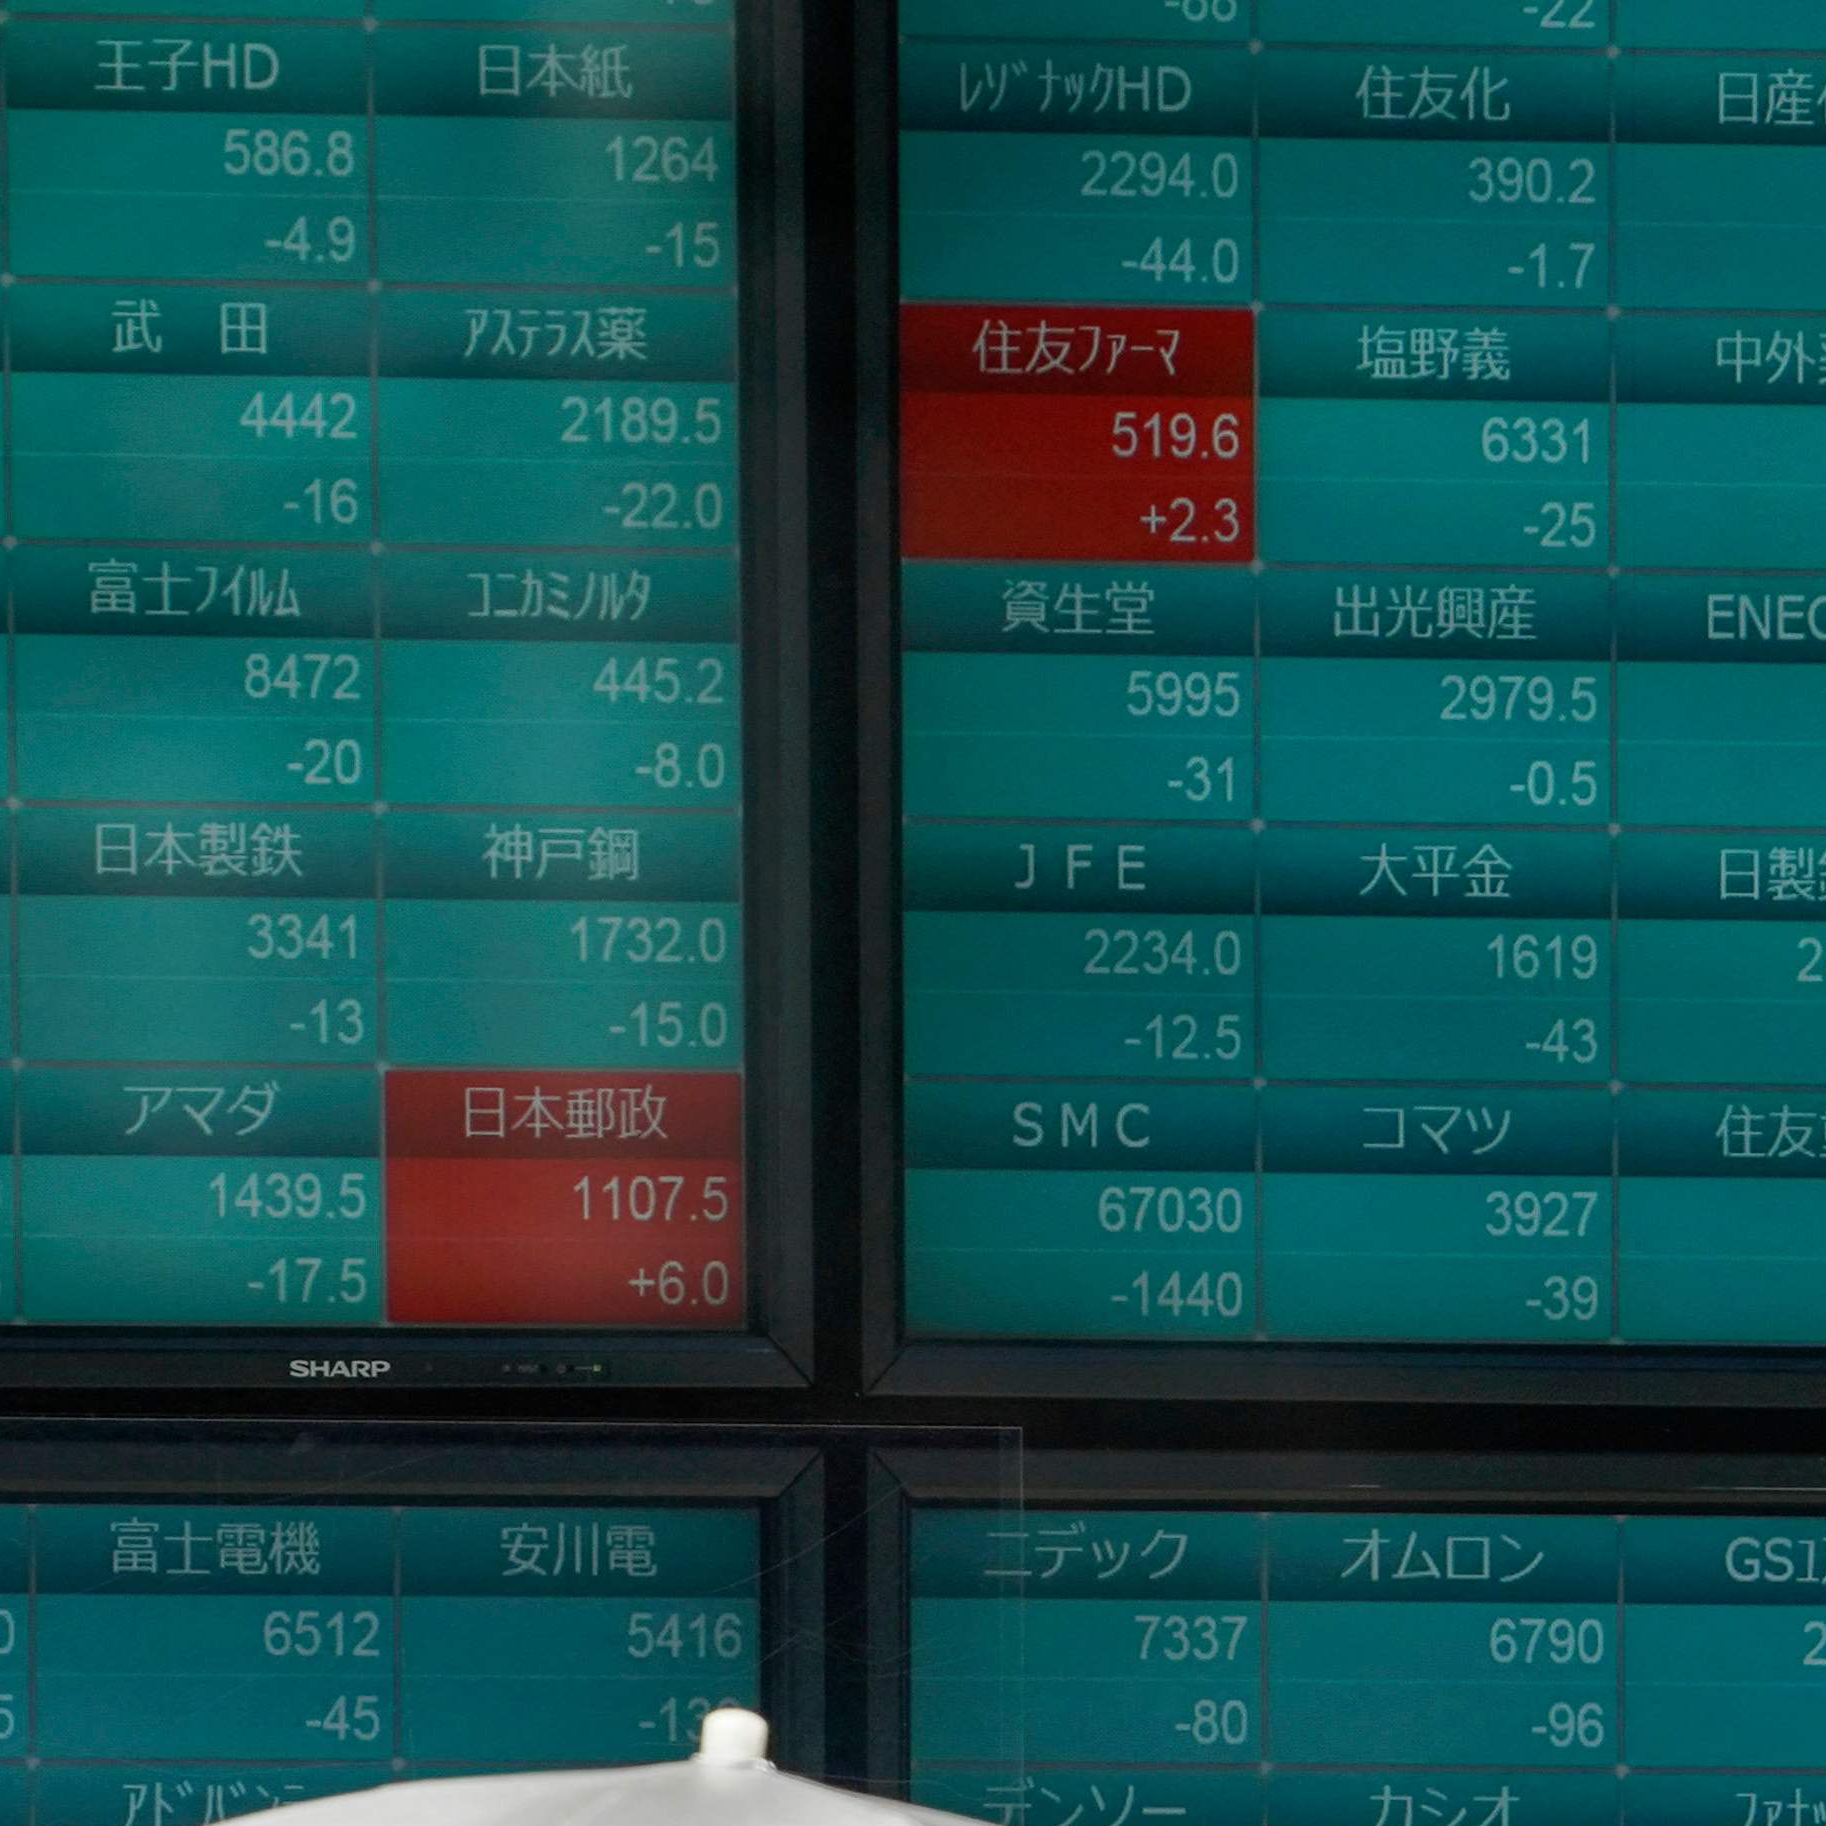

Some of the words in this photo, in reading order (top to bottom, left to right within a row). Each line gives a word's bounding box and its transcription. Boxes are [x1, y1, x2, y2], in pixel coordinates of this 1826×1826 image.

[95, 39, 280, 91] 王子HD
[478, 44, 632, 98] 日本紙
[1356, 65, 1510, 121] 住友化
[607, 135, 718, 182] 1264
[1470, 157, 1595, 204] 390.2
[1357, 325, 1510, 380] 塩野義
[241, 391, 357, 439] 4442
[560, 395, 722, 445] 2189.5
[1112, 410, 1240, 460] 519.6
[1139, 496, 1240, 544] +2.3
[1002, 580, 1155, 635] 資生堂
[592, 657, 723, 705] 445.2
[95, 821, 303, 877] 日本製鉄
[482, 823, 638, 880] 神戸鋼
[1360, 843, 1512, 897] 大平金
[247, 912, 356, 960] 3341
[570, 915, 726, 963] 1732.0
[125, 1081, 279, 1135] アマダ
[465, 1084, 667, 1139] 日本郵政
[1364, 1106, 1510, 1155] コマツ
[574, 1175, 728, 1222] 1107.5
[1486, 1190, 1598, 1237] 3927
[629, 1260, 728, 1305] +6.0
[288, 1359, 392, 1378] SHARP
[110, 1517, 320, 1575] 富士電機
[501, 1522, 657, 1577] 安川電
[1341, 1528, 1544, 1582] オムロン
[628, 1612, 741, 1658] 5416
[1134, 1614, 1247, 1661] 7337
